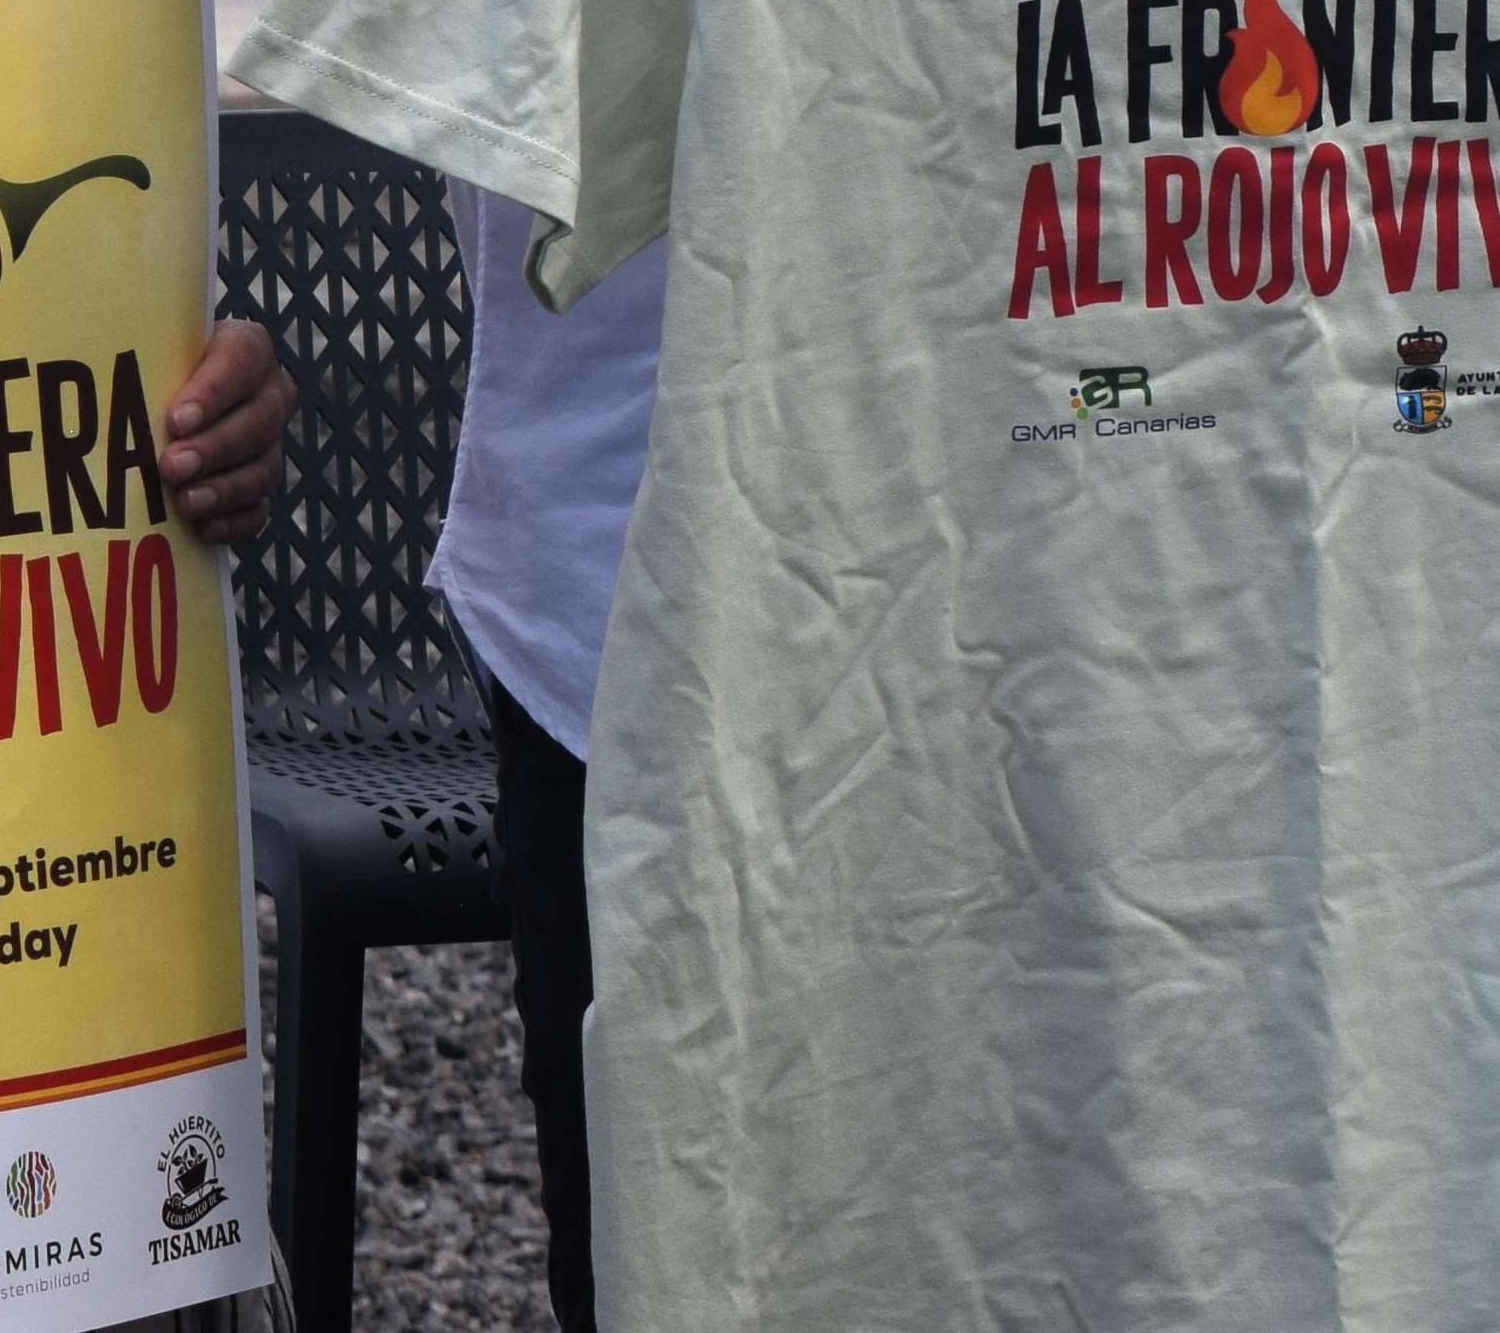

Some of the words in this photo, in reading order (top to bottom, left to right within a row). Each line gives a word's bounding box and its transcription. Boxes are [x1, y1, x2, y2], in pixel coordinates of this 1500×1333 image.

[1007, 155, 1123, 320] AL
[1143, 141, 1350, 308] ROJO
[1456, 386, 1476, 396] DE
[1011, 423, 1076, 442] GMR
[1095, 413, 1217, 436] Canarias
[157, 1147, 171, 1173] EL
[168, 1115, 226, 1160] HUERTITO
[149, 1219, 242, 1265] TISAMAR
